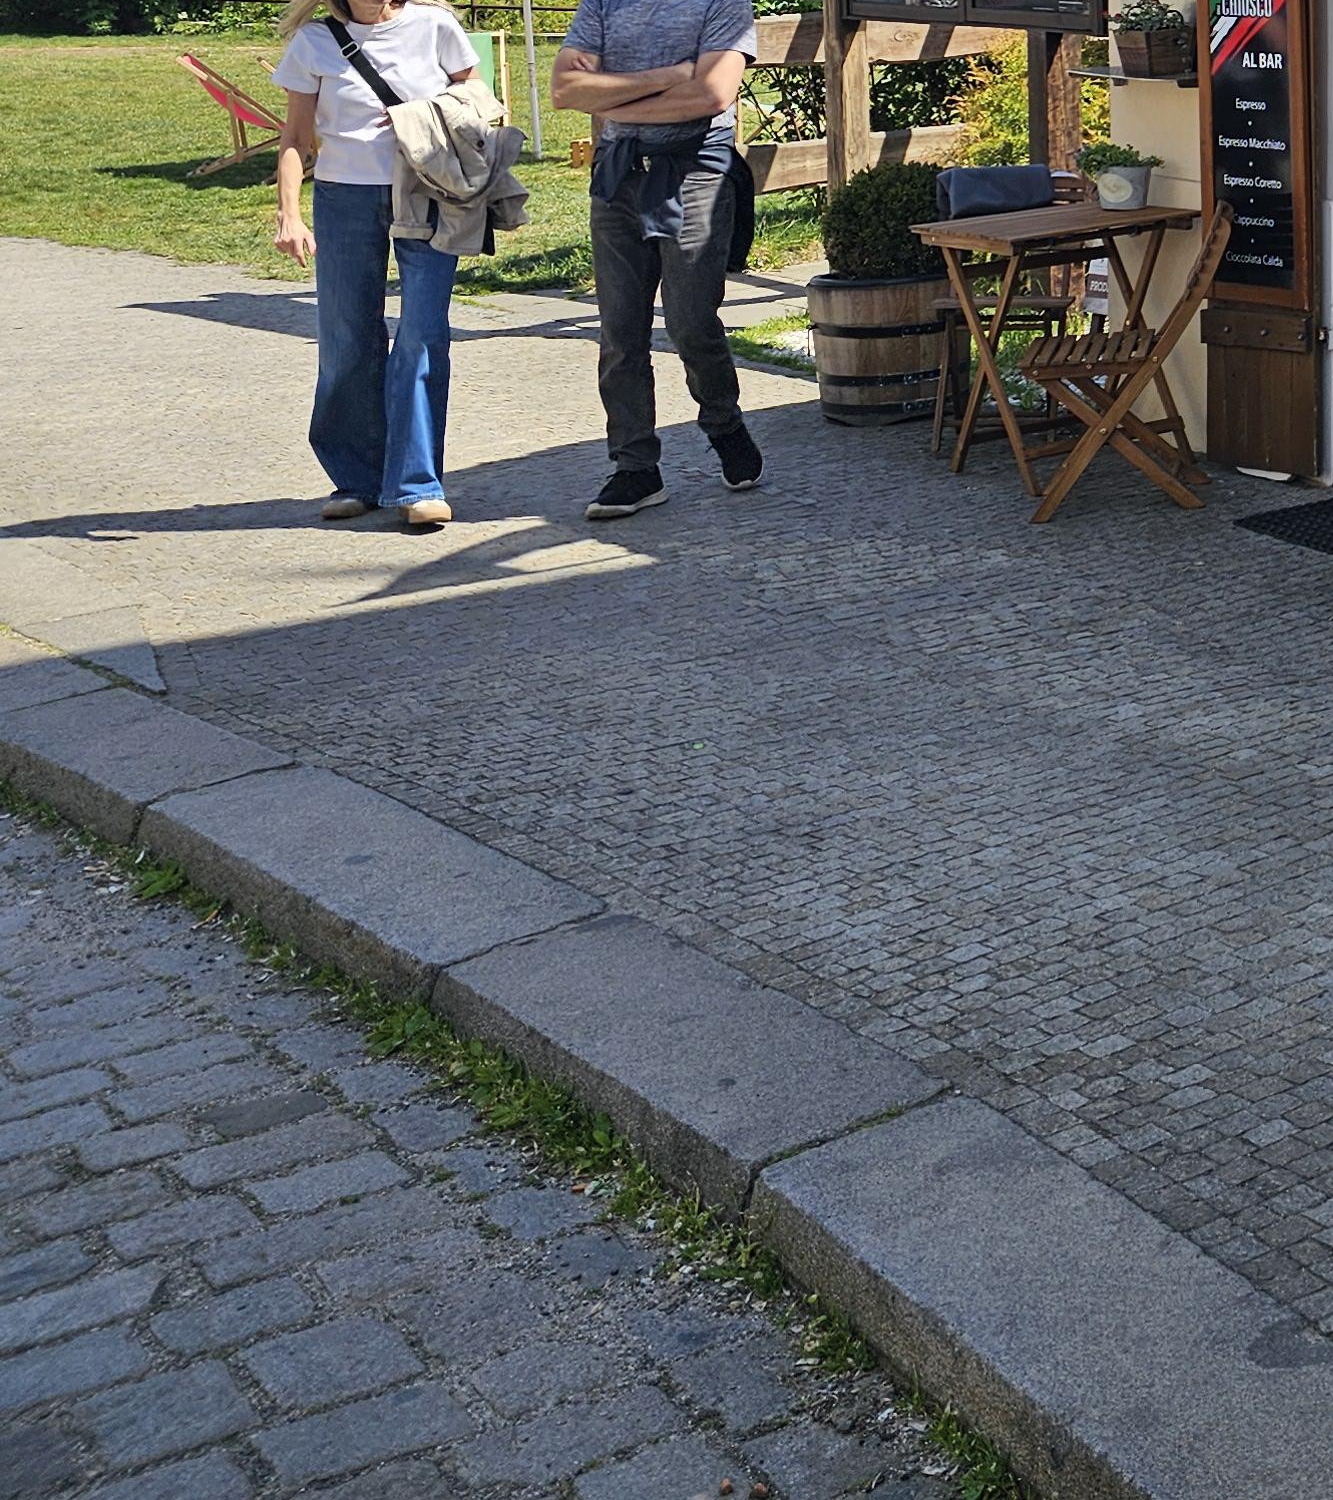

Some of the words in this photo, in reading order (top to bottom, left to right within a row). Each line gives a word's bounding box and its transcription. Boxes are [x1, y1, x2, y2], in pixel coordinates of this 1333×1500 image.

[1242, 51, 1258, 68] AL
[1258, 52, 1283, 69] BAR
[1235, 97, 1267, 111] Espresso
[1218, 134, 1248, 149] Espresso
[1249, 137, 1286, 151] Macchiato
[1223, 173, 1254, 189] Espresso
[1233, 212, 1275, 228] Cappuccino
[1225, 250, 1262, 265] Cioccolata
[1262, 253, 1284, 268] Calda
[1089, 280, 1109, 292] PROD
